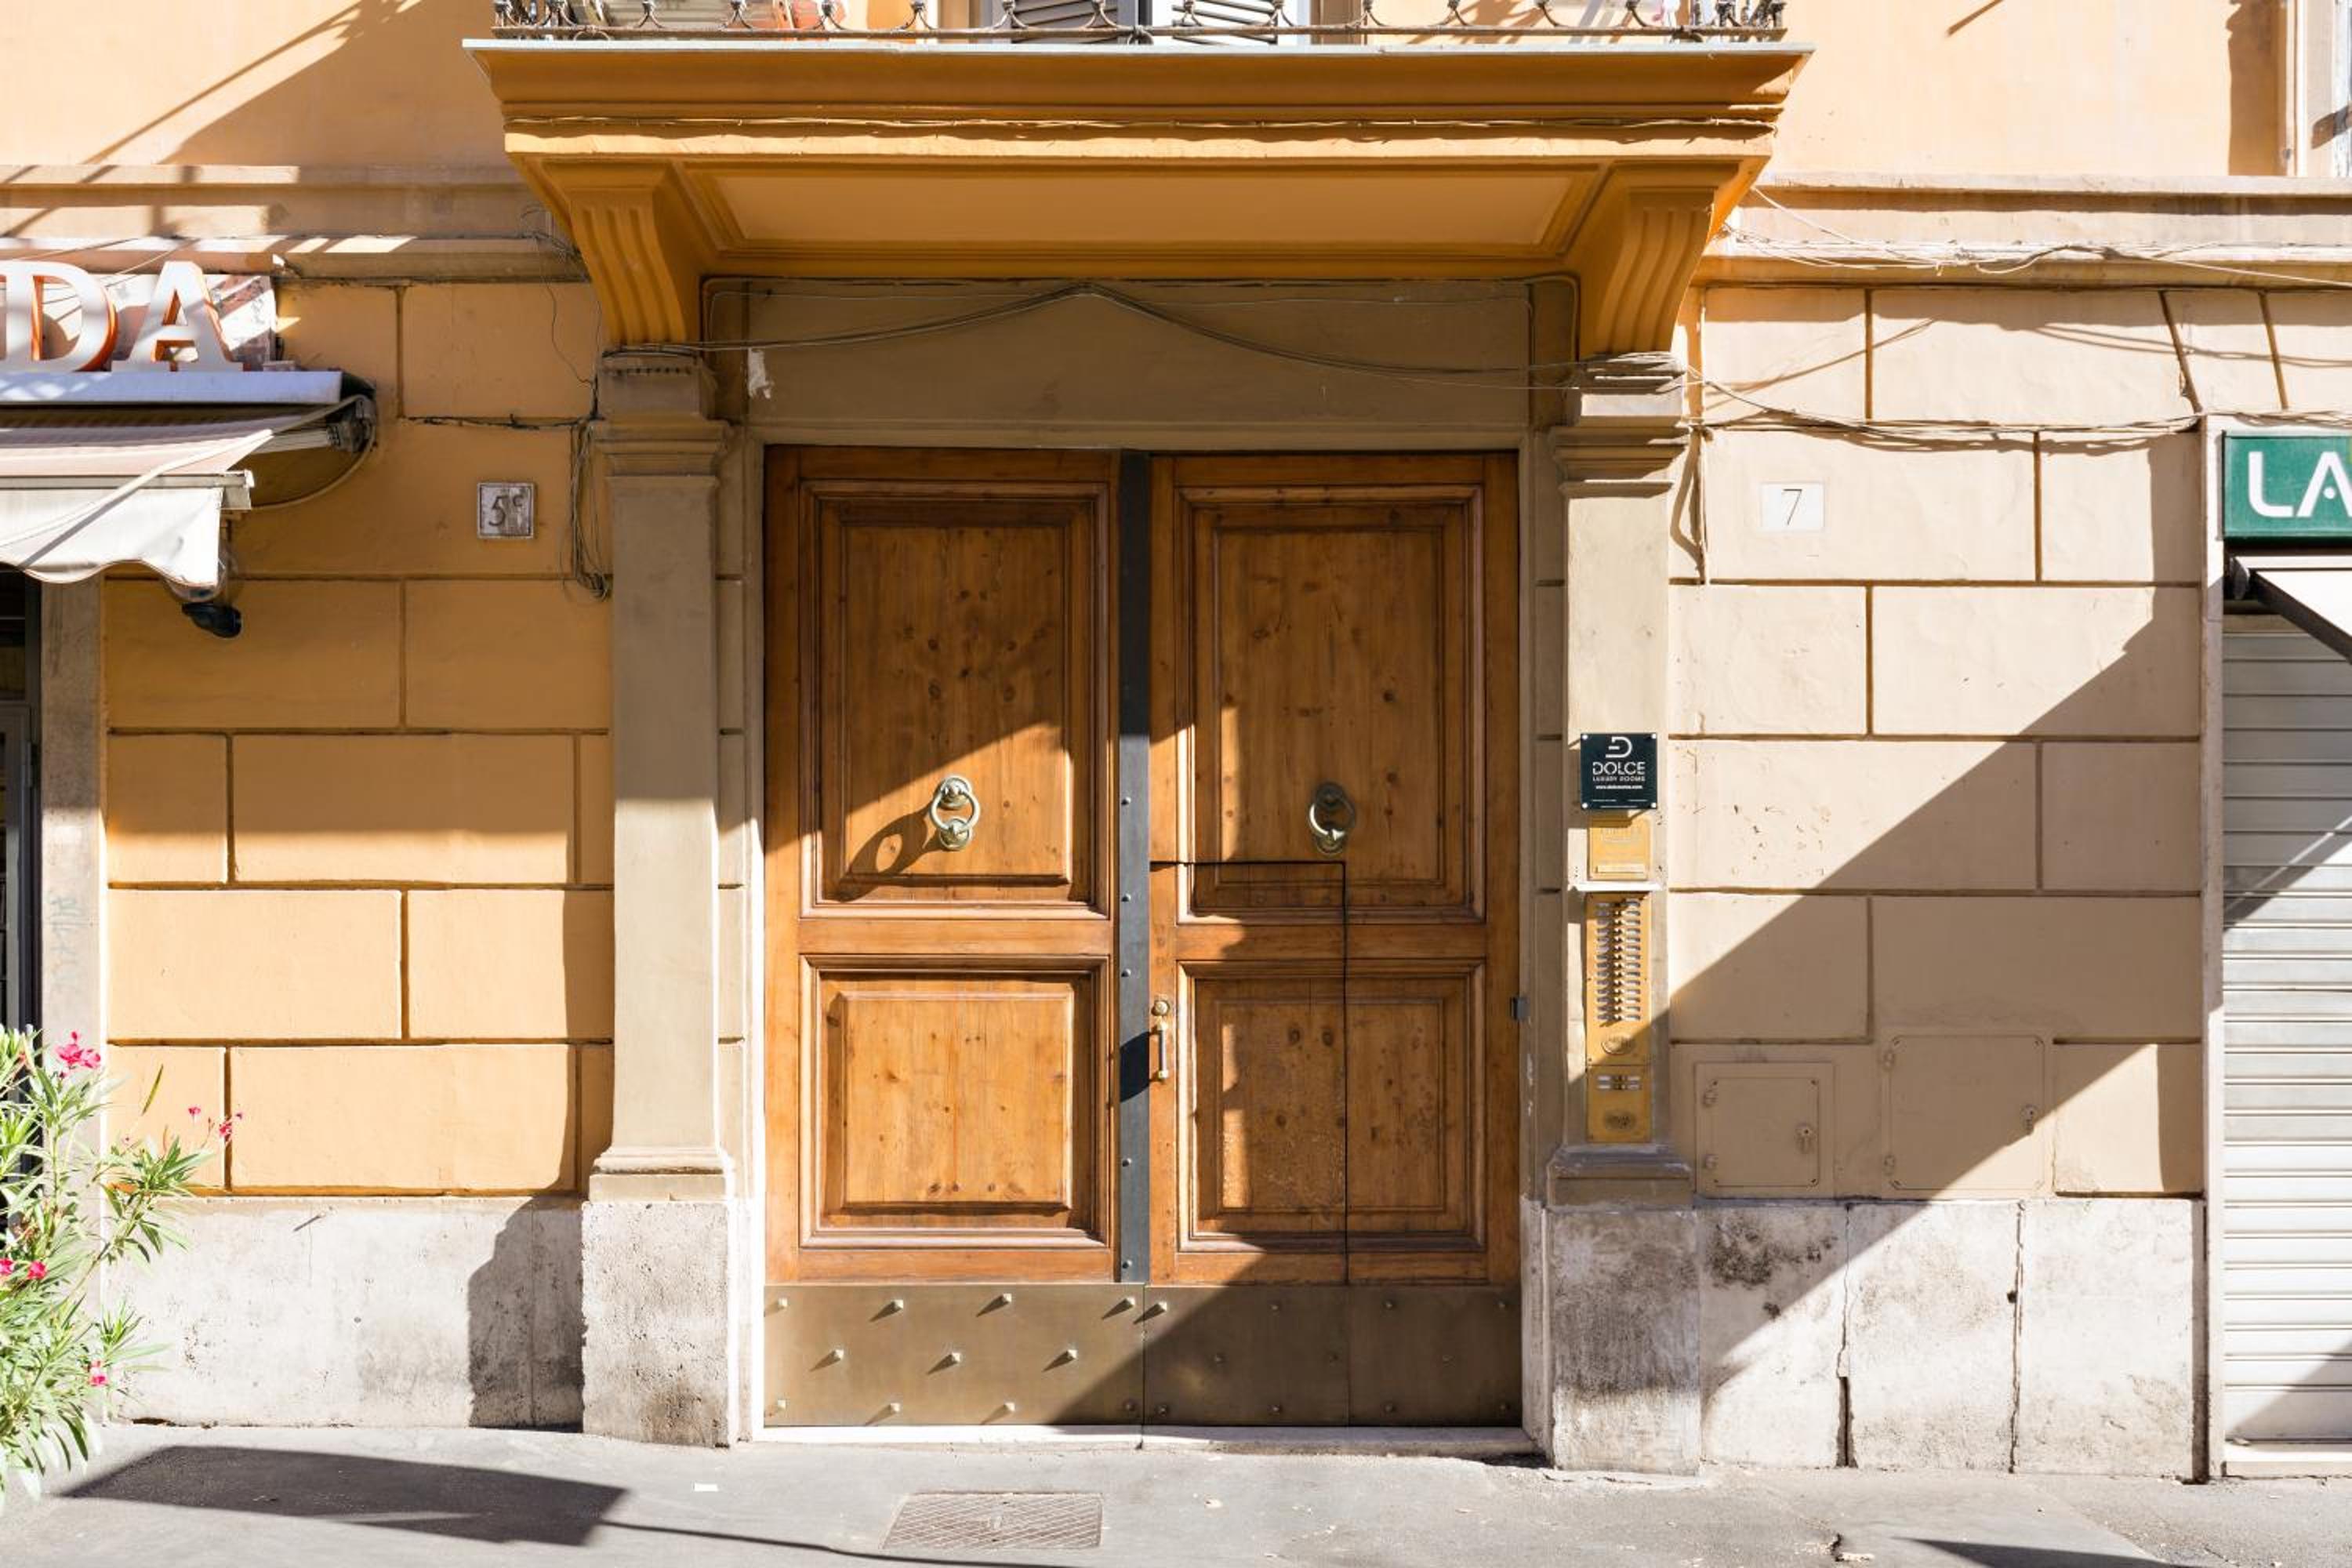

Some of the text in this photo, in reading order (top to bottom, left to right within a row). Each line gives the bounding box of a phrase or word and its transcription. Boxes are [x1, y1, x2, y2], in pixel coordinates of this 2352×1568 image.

[2249, 451, 2352, 517] LA
[1783, 488, 1802, 525] 7
[1592, 761, 1646, 775] DOLCE
